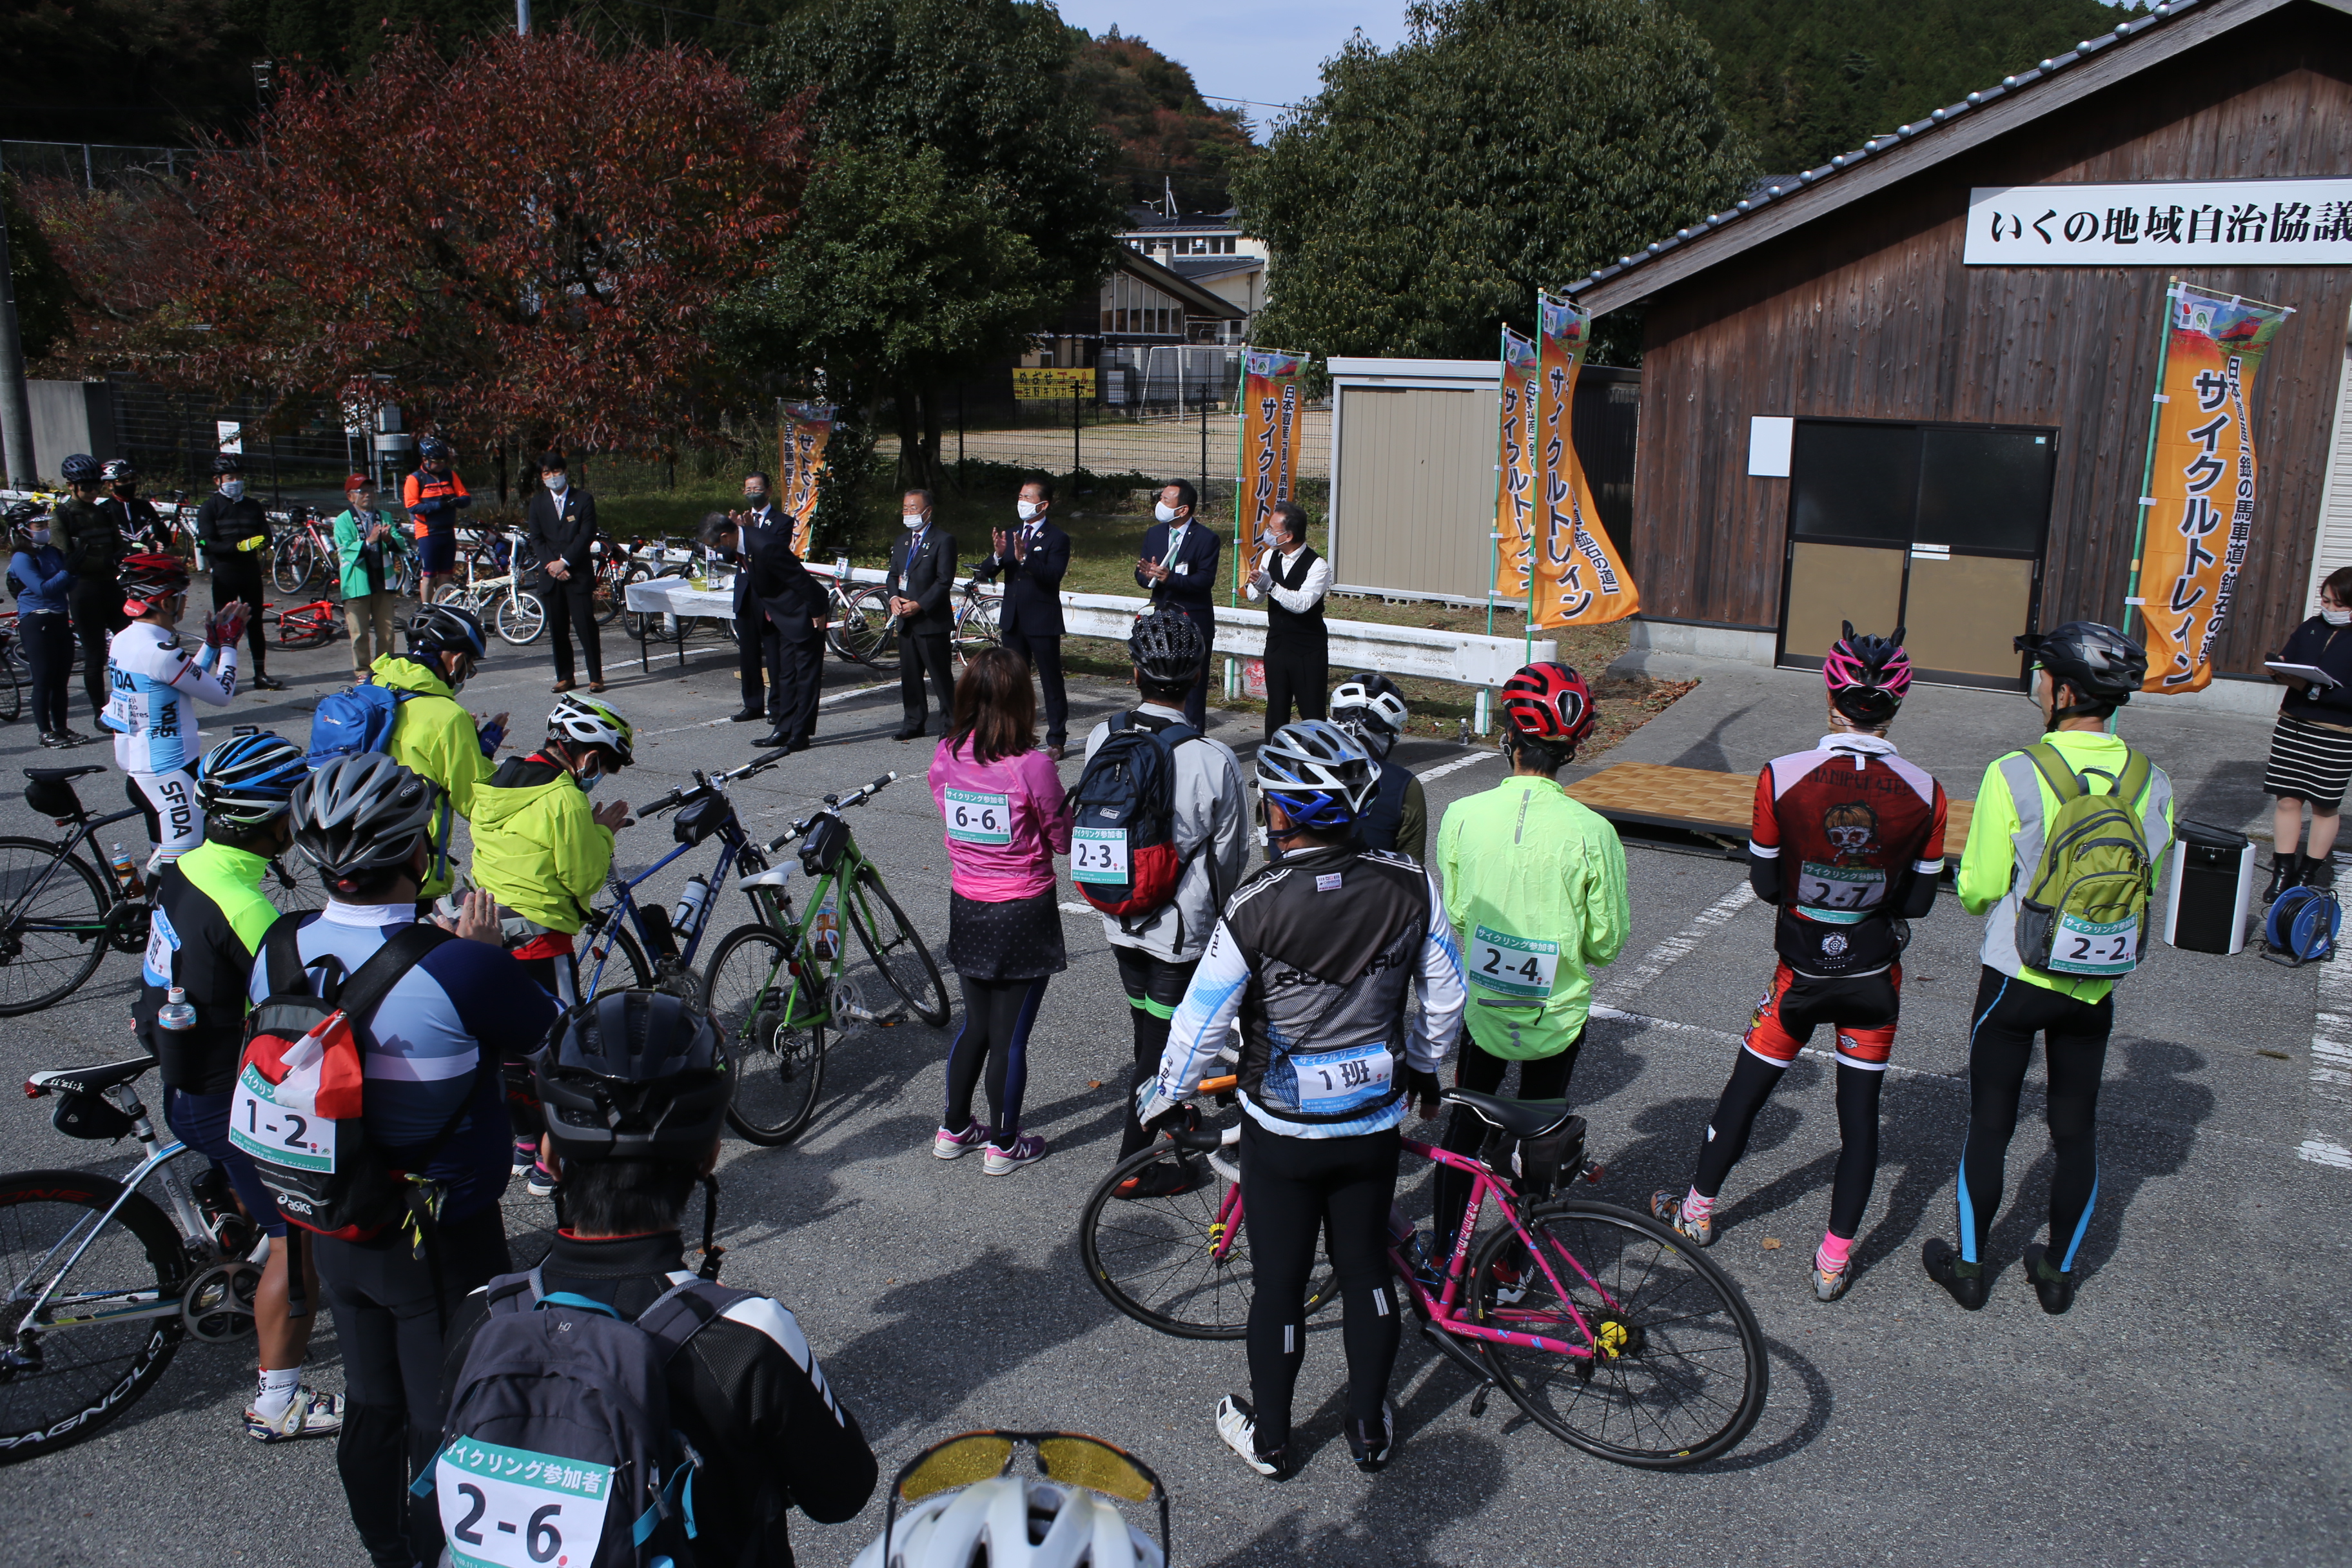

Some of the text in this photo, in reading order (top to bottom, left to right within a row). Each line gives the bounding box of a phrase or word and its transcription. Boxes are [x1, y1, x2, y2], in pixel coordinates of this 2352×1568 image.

[1991, 201, 2352, 245] いくの地域自治協議
[1547, 367, 1593, 618] サイクルトレイン
[2166, 372, 2230, 686] サイクルトレイン
[221, 665, 236, 695] SFIDA
[161, 700, 178, 738] SFIDA
[946, 790, 1004, 804] サイクリング参加者
[159, 781, 193, 839] SFIDA
[956, 806, 995, 830] 6-6
[1074, 829, 1123, 838] サイクリング参加者
[1079, 843, 1112, 868] 2-3
[1805, 865, 1881, 881] サイクリング参加者
[1812, 882, 1868, 908] 2-7
[2066, 917, 2135, 933] サイクリング参加者
[1478, 929, 1555, 953] サイクリング参加者
[2070, 936, 2126, 961] 2-2
[1483, 948, 1538, 981] 2-4
[1298, 1047, 1377, 1064] サイクルリーダー
[247, 1099, 308, 1149] 1-2
[288, 1200, 312, 1215] asics
[1525, 1265, 1535, 1284] DMT
[455, 1482, 562, 1563] 2-6
